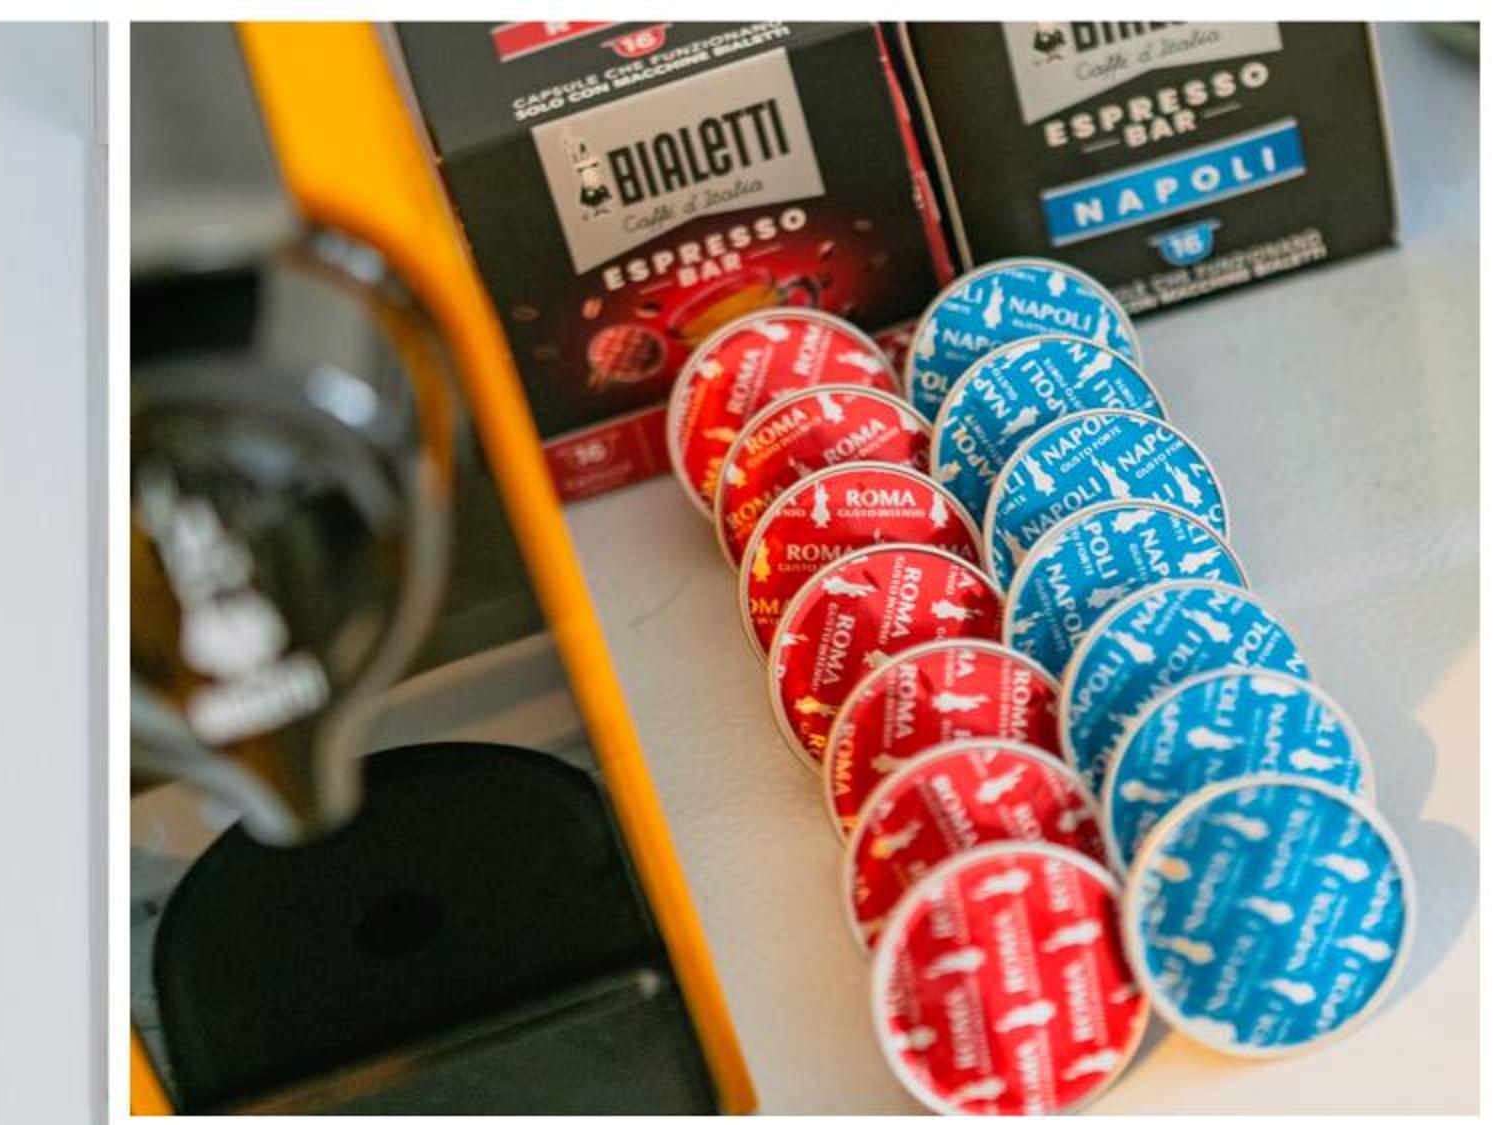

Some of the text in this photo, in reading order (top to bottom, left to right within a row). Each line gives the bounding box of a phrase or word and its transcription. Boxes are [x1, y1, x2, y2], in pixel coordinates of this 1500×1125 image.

[626, 29, 657, 53] 16
[512, 73, 599, 110] CAPSULE
[605, 59, 645, 82] CHE
[514, 25, 791, 121] SOLO CON MACCHINE BIALETTI
[1044, 61, 1269, 148] ESPRESSO
[1123, 108, 1197, 148] BAR
[1072, 146, 1277, 227] NAPOLI
[602, 208, 808, 292] ESPRESSO
[675, 252, 743, 289] BAR
[1008, 295, 1093, 331] NAPOLI
[727, 347, 764, 415] ROMA
[744, 406, 809, 455] ROMA
[823, 418, 889, 466] ROMA
[1041, 411, 1118, 465] NAPOL
[845, 489, 917, 507] ROMA
[890, 566, 923, 638] ROMA
[821, 613, 857, 686] ROMA
[895, 663, 919, 738] ROMA
